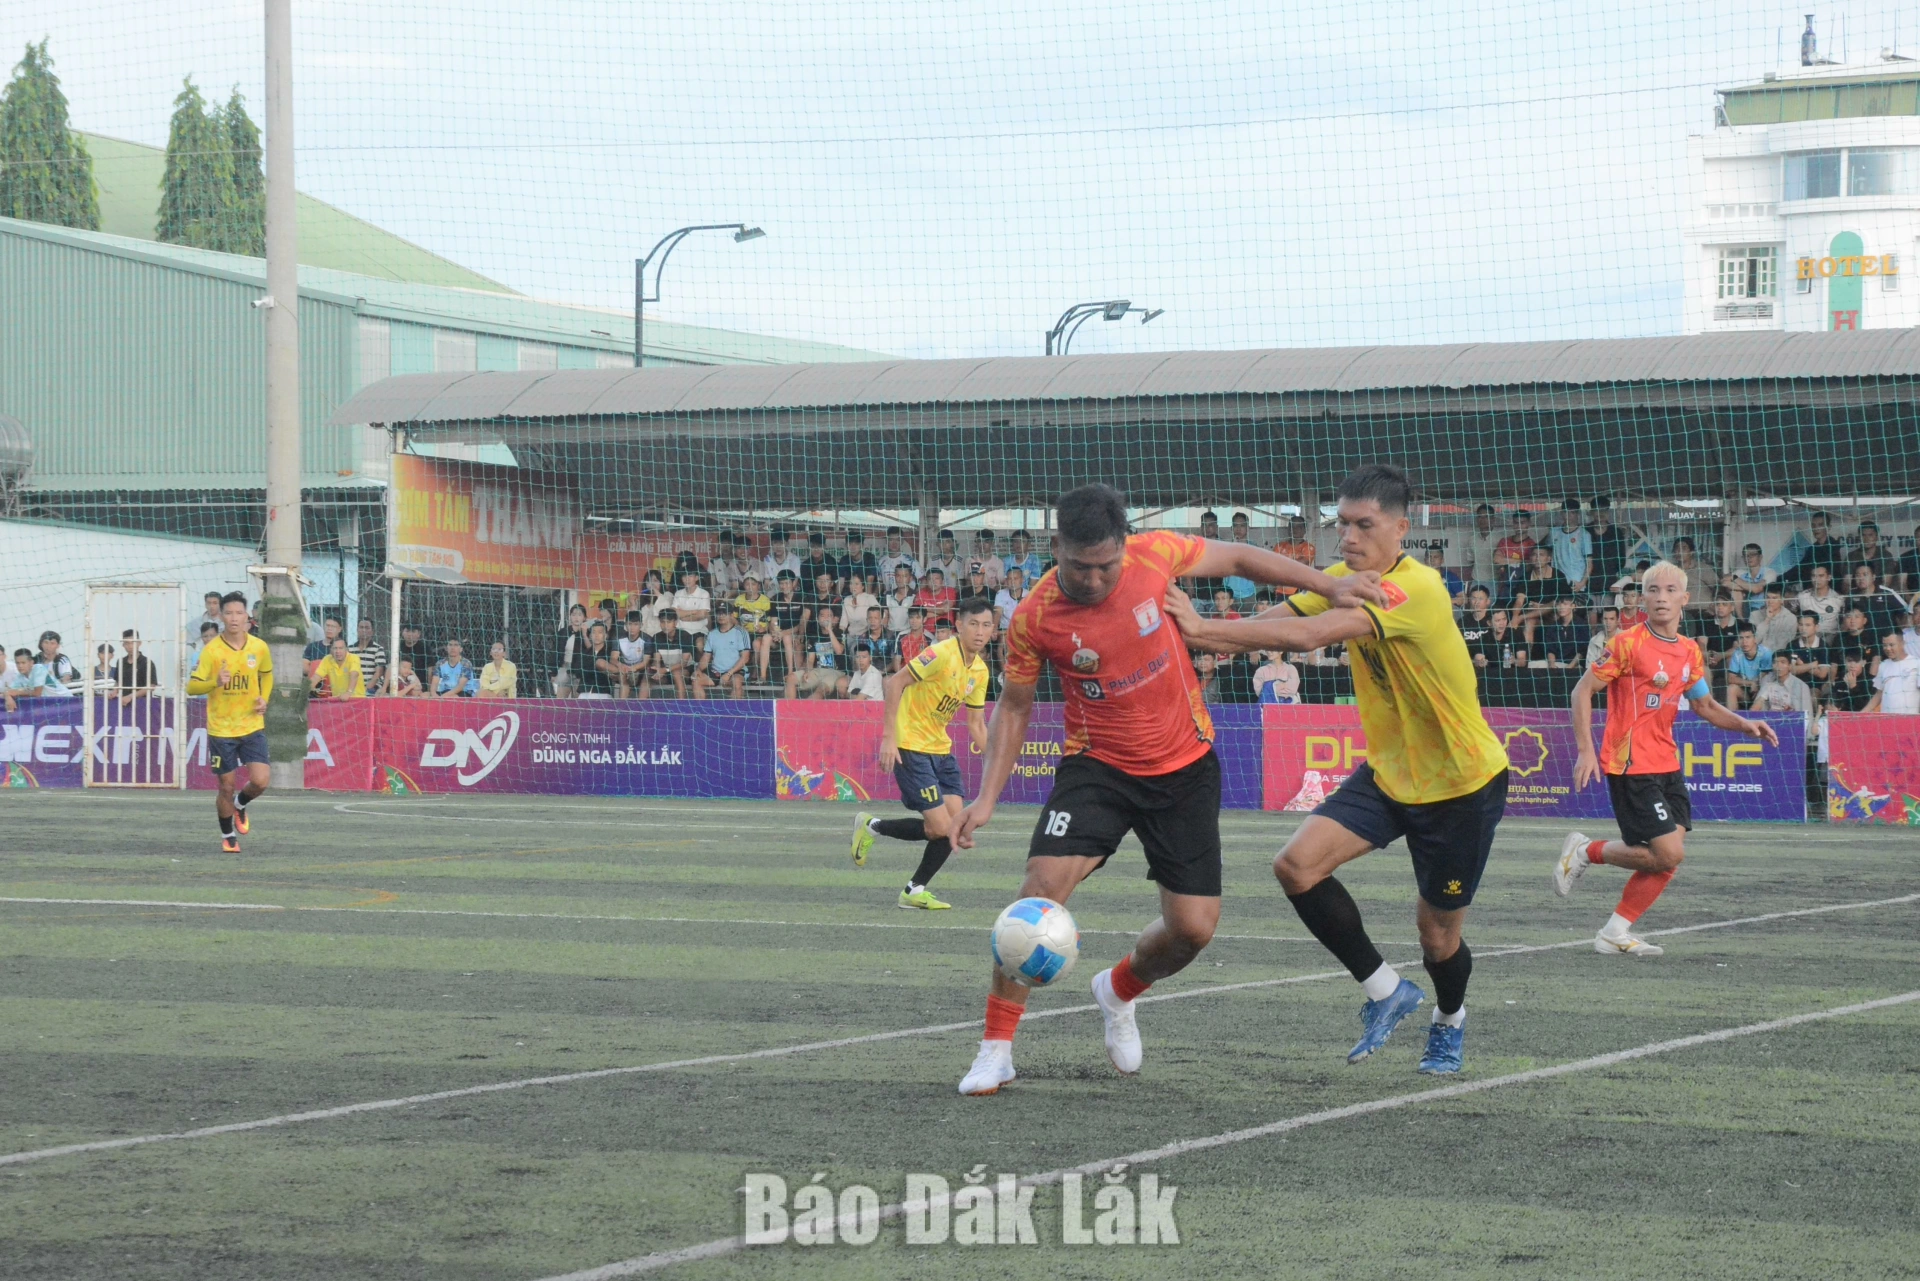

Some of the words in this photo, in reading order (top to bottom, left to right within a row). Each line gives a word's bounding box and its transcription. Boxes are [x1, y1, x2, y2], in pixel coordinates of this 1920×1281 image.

[1796, 254, 1899, 280] HOTEL
[434, 480, 470, 533] TẤM
[472, 484, 574, 549] THANH
[630, 539, 655, 553] HÀNG
[1400, 539, 1427, 549] UNG
[1148, 649, 1170, 673] DUY
[532, 730, 567, 744] CÔNG
[568, 733, 581, 744] TY
[583, 733, 611, 745] TNHH
[533, 745, 577, 764] DŨNG
[580, 749, 612, 764] NGA
[615, 746, 649, 765] ĐẮK
[651, 746, 682, 765] LẮK
[1306, 736, 1368, 769] DH
[1676, 743, 1763, 778] HF
[1017, 761, 1056, 777] nguồn
[920, 785, 939, 803] 47
[1508, 784, 1527, 795] HỰA
[1529, 785, 1549, 794] HOA
[1550, 786, 1570, 794] SEN
[1699, 783, 1726, 792] CUP
[1542, 796, 1559, 804] phúc
[1654, 802, 1668, 821] 5
[1045, 810, 1072, 837] 16
